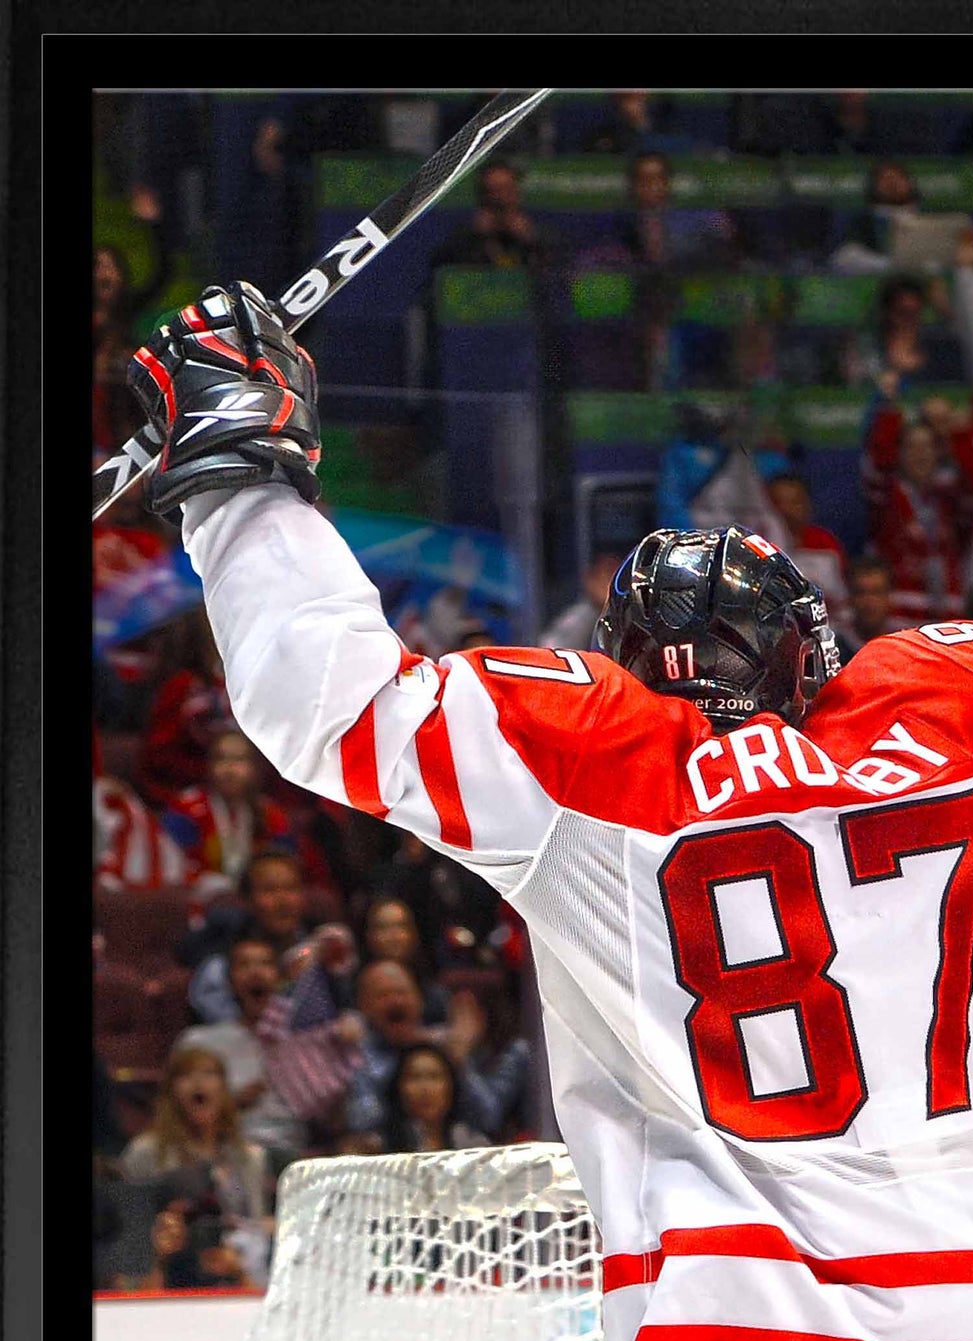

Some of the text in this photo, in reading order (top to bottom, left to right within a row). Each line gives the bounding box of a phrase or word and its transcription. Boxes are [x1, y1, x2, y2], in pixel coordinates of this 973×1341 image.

[663, 643, 695, 680] 87
[717, 699, 755, 711] 2010
[686, 722, 949, 815] CROBY
